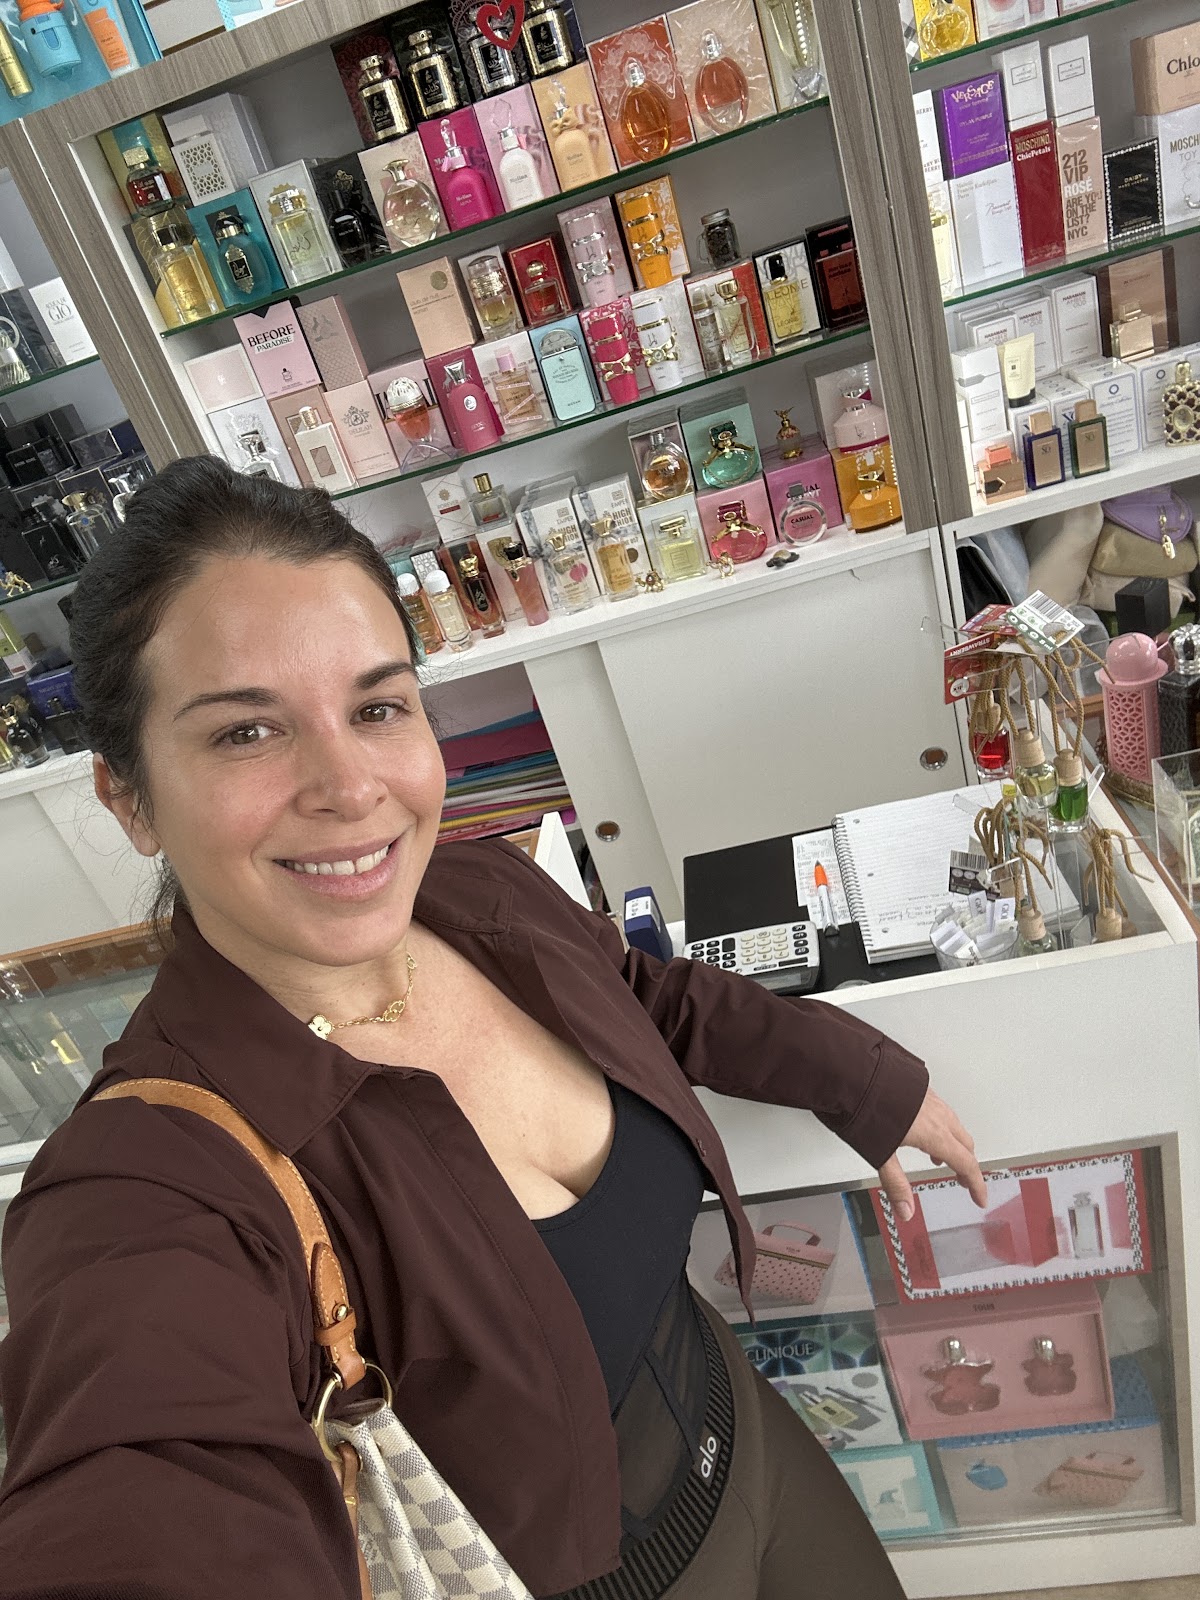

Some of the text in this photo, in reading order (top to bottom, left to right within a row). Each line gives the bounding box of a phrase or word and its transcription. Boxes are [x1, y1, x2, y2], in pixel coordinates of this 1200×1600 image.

[951, 80, 995, 103] VERSACE
[1015, 133, 1050, 153] MOSCHINO
[1016, 146, 1051, 161] ChicPetals
[1062, 149, 1087, 170] 212
[1179, 151, 1197, 163] TOY
[1064, 165, 1088, 183] VIP
[1065, 195, 1083, 210] ARE
[1066, 201, 1096, 219] ON THE
[1066, 214, 1090, 228] LIST?
[1067, 226, 1088, 240] NYC
[49, 304, 72, 321] GIO
[247, 324, 296, 347] BEFORE
[256, 335, 293, 352] PARADISE
[612, 508, 632, 520] HIGH
[790, 514, 814, 524] CASUAL
[949, 637, 991, 657] STRAWBERRY
[745, 1342, 813, 1362] CLINIQUE
[699, 1436, 717, 1478] alo
